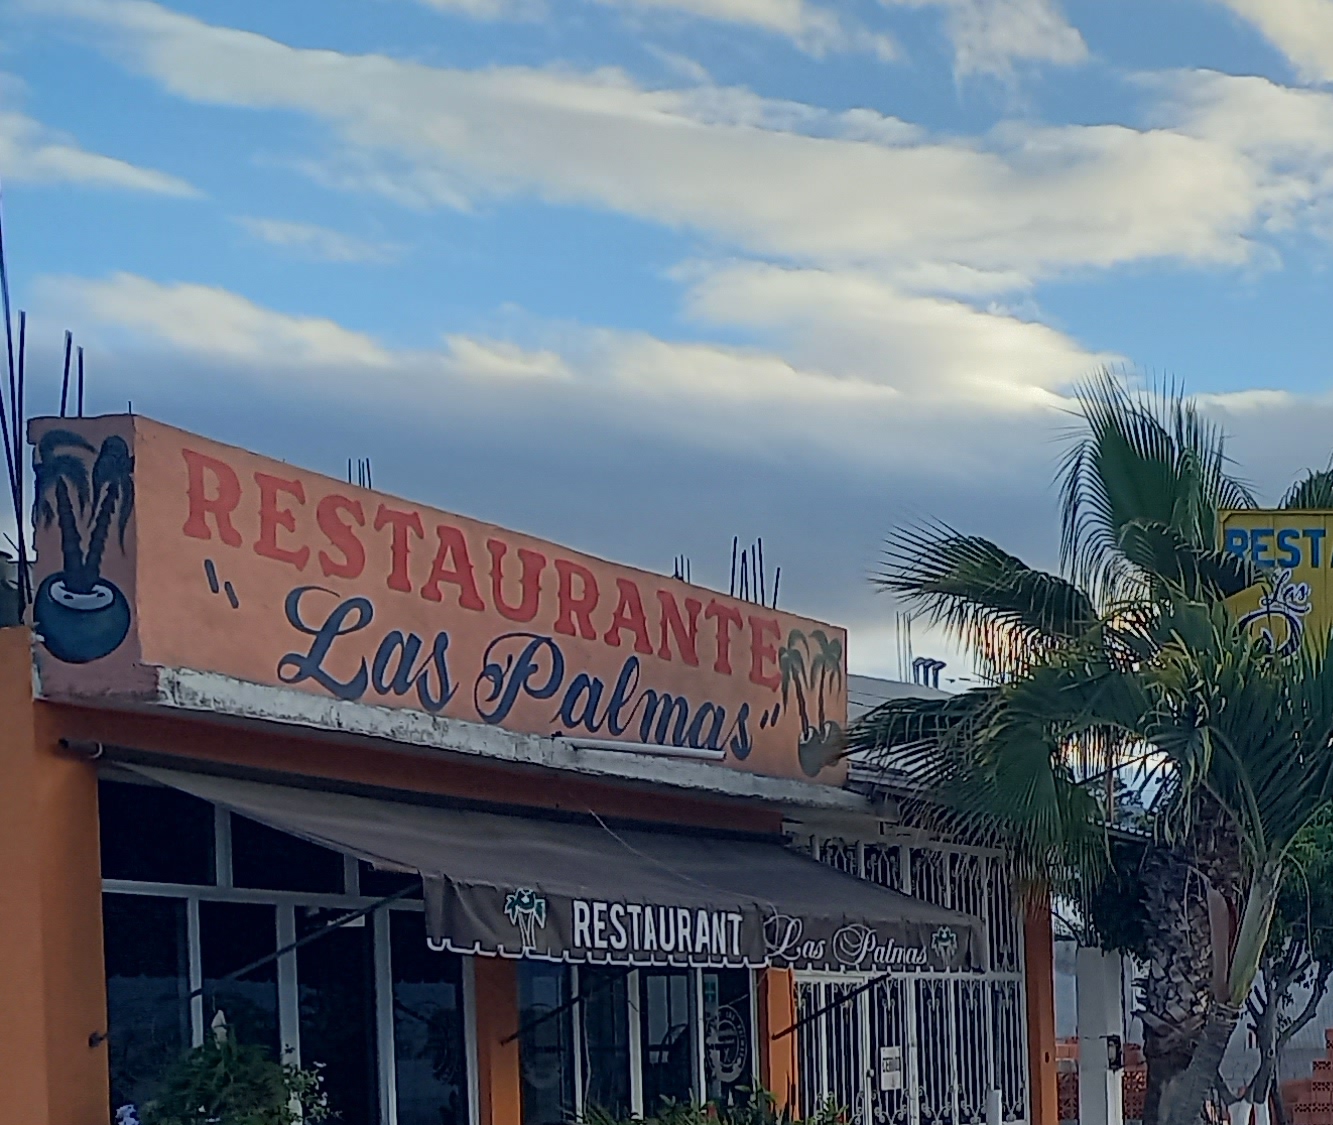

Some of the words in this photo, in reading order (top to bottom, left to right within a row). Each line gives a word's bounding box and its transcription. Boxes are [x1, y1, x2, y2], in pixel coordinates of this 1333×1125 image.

[181, 448, 783, 692] RESTAURANTE
[1260, 568, 1312, 614] Las
[573, 899, 743, 956] RESTAURANT
[763, 914, 826, 961] Las
[833, 923, 928, 966] Palmas
